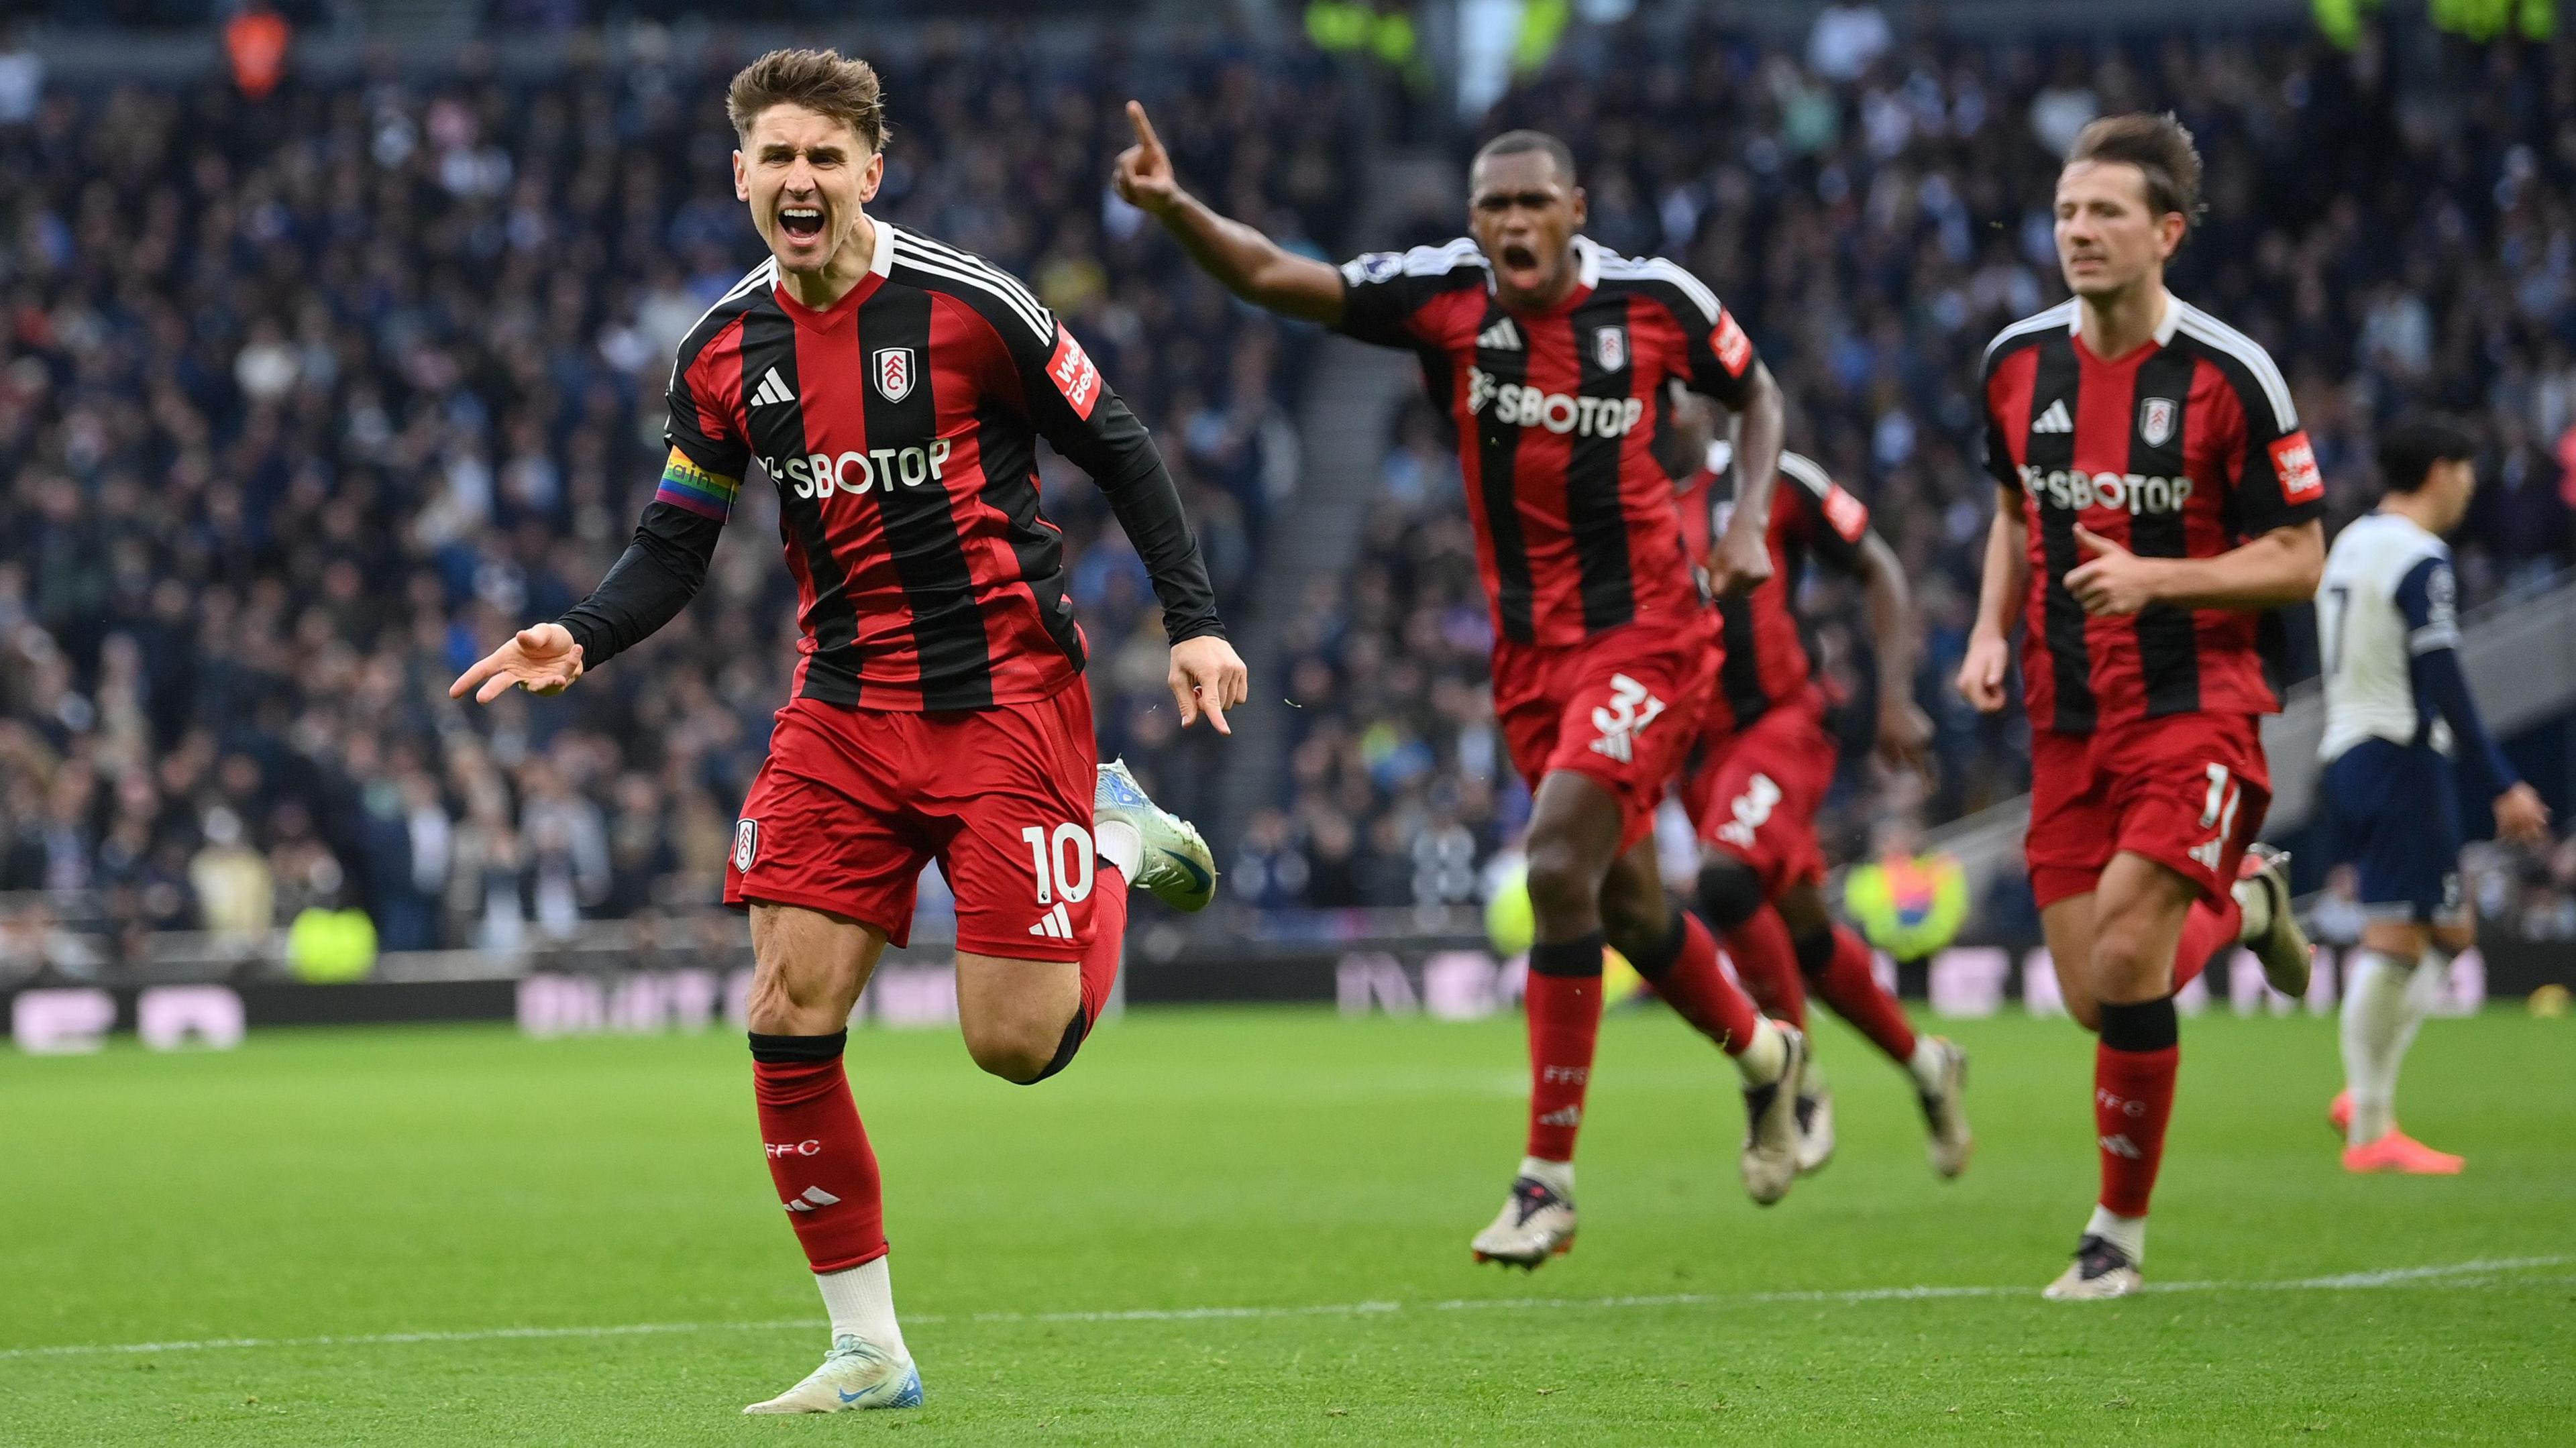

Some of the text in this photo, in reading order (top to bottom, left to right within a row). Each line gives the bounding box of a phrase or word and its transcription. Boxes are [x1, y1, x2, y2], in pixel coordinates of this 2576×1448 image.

[884, 355, 904, 390] FFC
[1495, 382, 1644, 439] SBOTOP
[785, 438, 951, 499] SBOTOP
[2047, 469, 2194, 515] SBOTOP
[2329, 587, 2350, 674] 7
[1591, 672, 1666, 738] 31
[739, 827, 751, 860] FFC
[1022, 822, 1094, 904] 10
[1544, 1065, 1589, 1085] FFC
[764, 1139, 820, 1159] FFC
